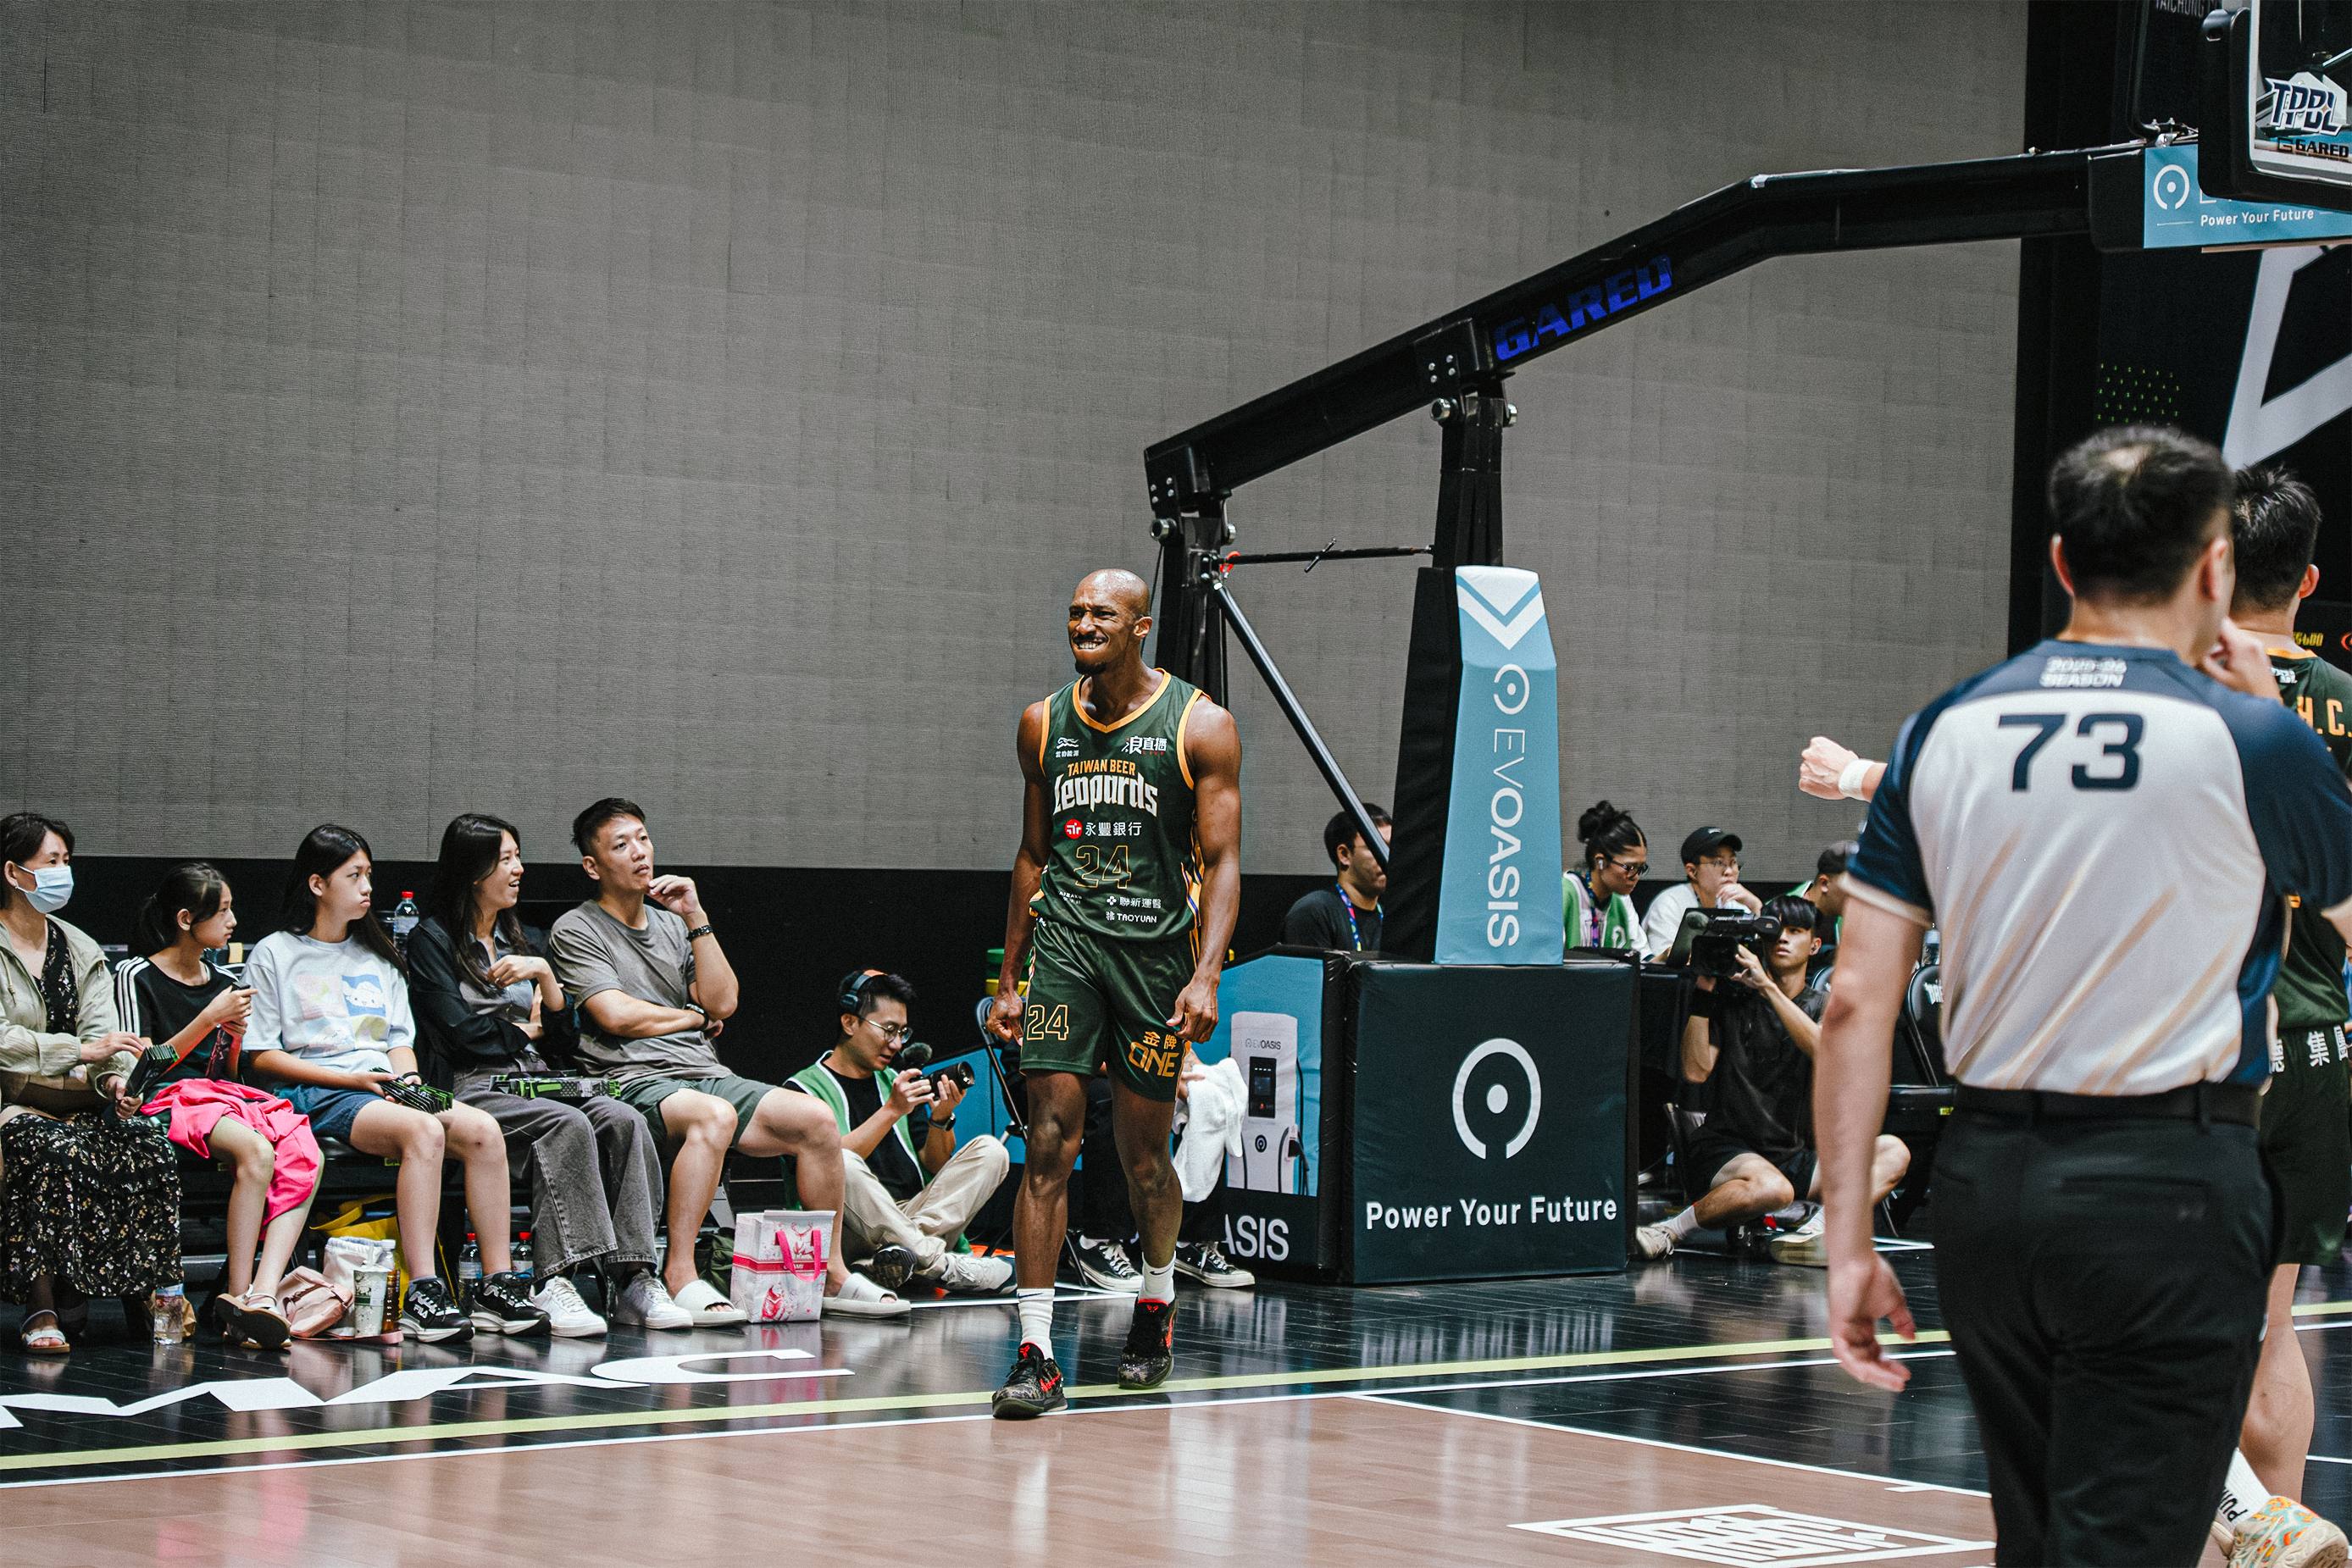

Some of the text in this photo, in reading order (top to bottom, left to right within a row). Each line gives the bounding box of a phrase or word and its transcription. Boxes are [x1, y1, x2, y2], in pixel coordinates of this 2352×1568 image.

[2295, 139, 2349, 158] GARED
[2201, 209, 2314, 226] Power Your Future
[1494, 255, 1672, 361] GARED
[2039, 673, 2124, 688] SEASON
[1121, 735, 1168, 755] 浪直播
[1998, 712, 2145, 792] 73
[1068, 758, 1136, 777] TAIWAN BEER
[1084, 821, 1142, 837] 永豐銀行
[1486, 728, 1525, 948] EVOASIS
[1073, 845, 1132, 889] 24
[1117, 912, 1157, 923] TAOYUAN
[1026, 1004, 1069, 1041] 24
[1143, 1030, 1177, 1050] 金牌
[1128, 1041, 1180, 1078] ONE
[1365, 1195, 1617, 1230] Power Your Future
[413, 1303, 429, 1319] FILA
